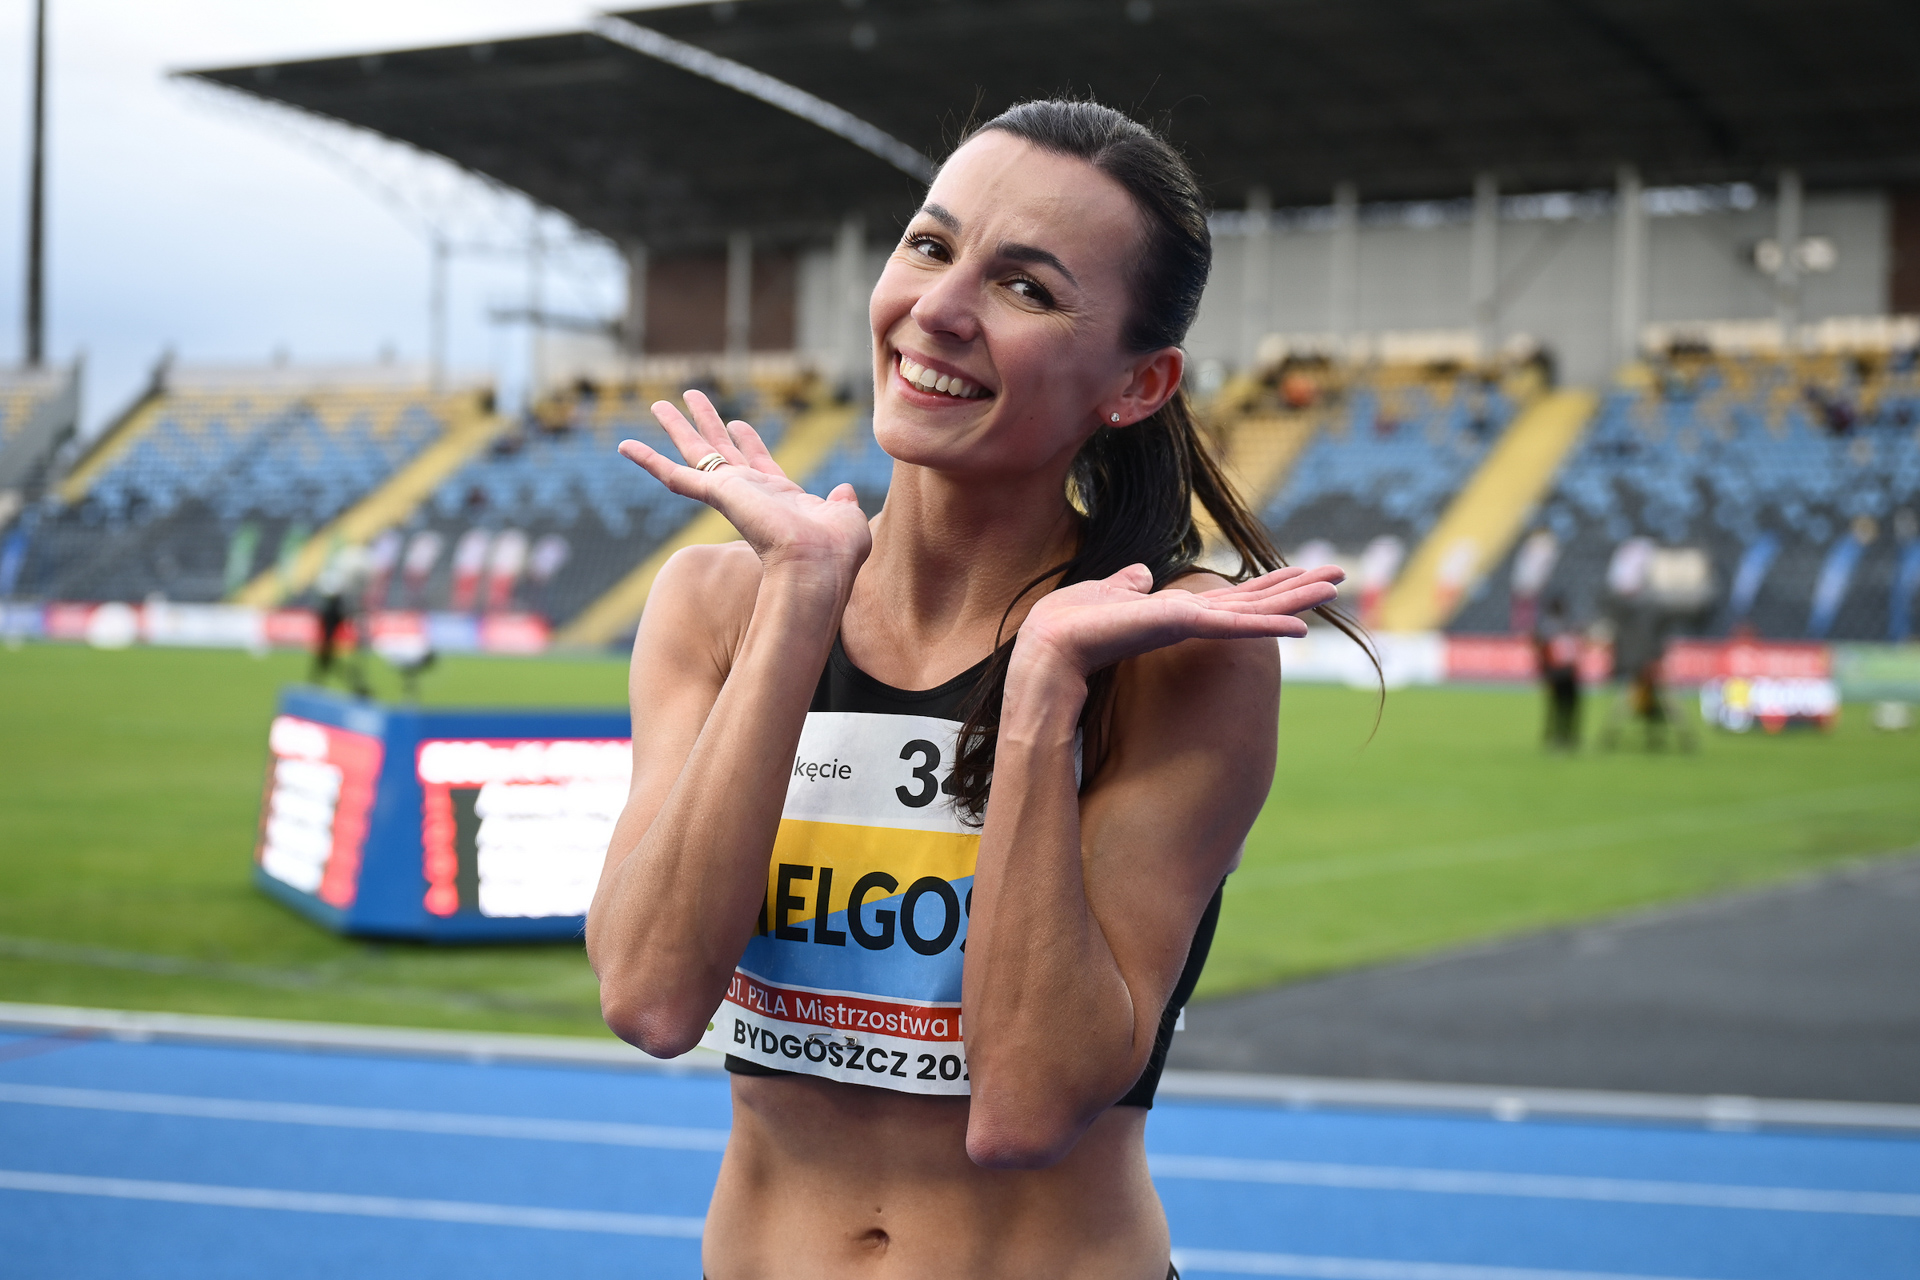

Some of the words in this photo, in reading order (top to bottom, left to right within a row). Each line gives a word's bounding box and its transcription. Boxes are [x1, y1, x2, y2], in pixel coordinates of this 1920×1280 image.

[793, 756, 852, 782] kęcie
[748, 984, 788, 1017] PZLA
[795, 997, 948, 1037] Mistrzostwa
[733, 1018, 908, 1077] BYDGOSZCZ
[916, 1053, 970, 1081] 20
